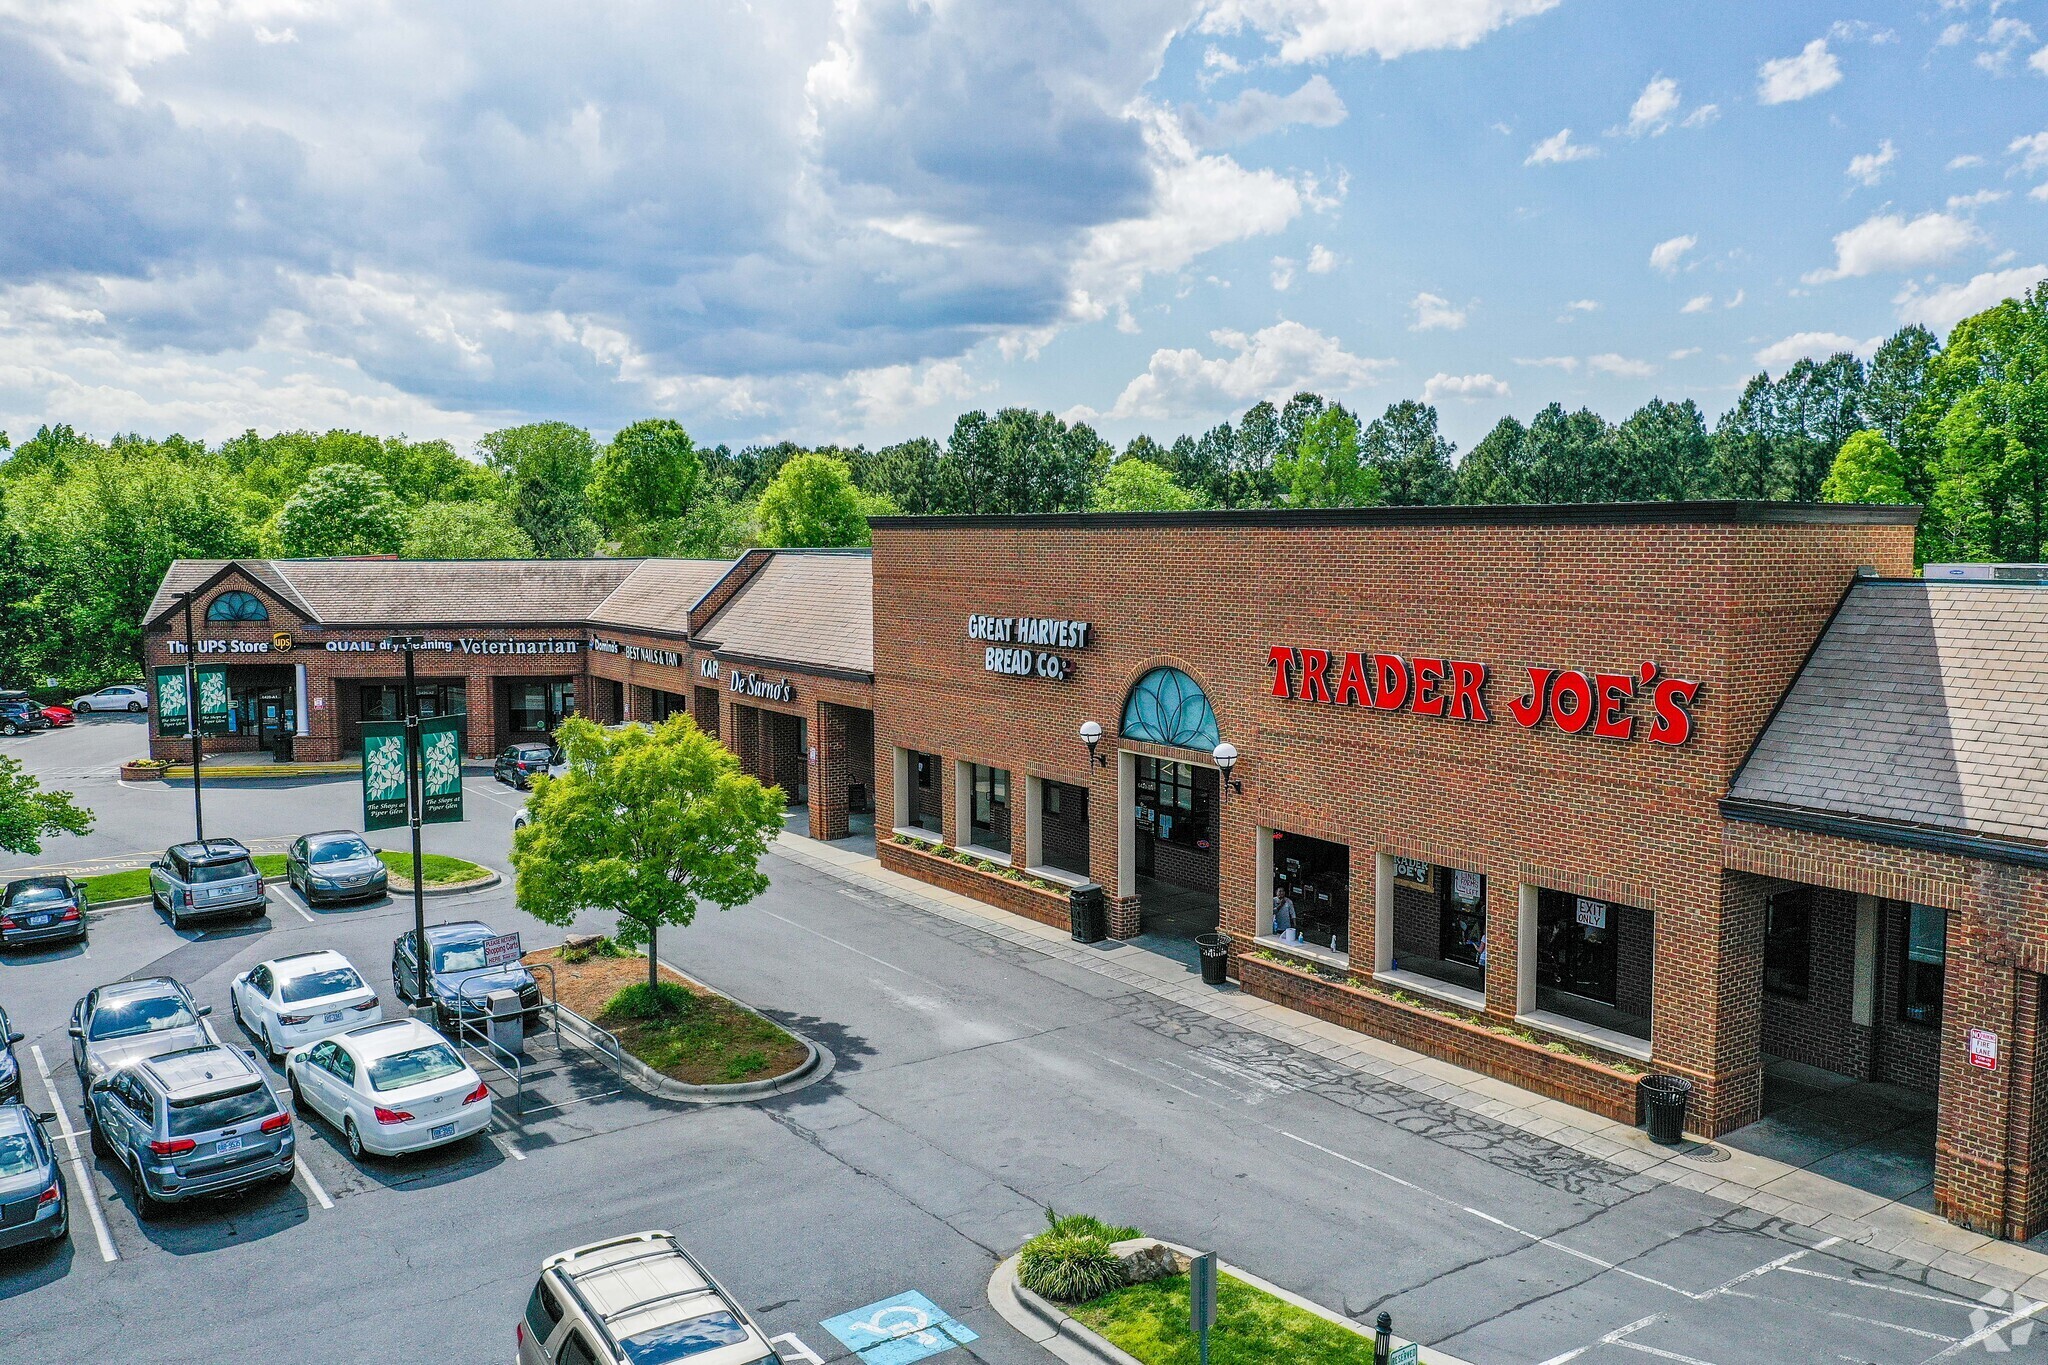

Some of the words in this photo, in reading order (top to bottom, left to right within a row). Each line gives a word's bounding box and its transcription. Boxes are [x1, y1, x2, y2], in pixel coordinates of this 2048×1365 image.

[967, 614, 1013, 642] GREAT
[1018, 617, 1087, 648] HARVEST
[198, 640, 226, 653] UPS
[230, 640, 268, 653] Store
[275, 638, 291, 650] ups
[325, 641, 375, 652] QUAIL
[402, 639, 453, 652] ceaning
[459, 638, 578, 654] Veterinarian
[595, 639, 619, 654] Domino's
[625, 645, 640, 660] BEST
[640, 648, 658, 664] NAILS
[659, 651, 664, 665] &
[665, 652, 678, 667] TAN
[985, 647, 1033, 675] BREAD
[701, 658, 720, 680] KAR
[730, 670, 745, 692] De
[747, 673, 790, 703] Sarno's
[1267, 645, 1491, 723] TRADER
[1507, 661, 1700, 746] JOE'S
[367, 803, 379, 811] The
[380, 802, 398, 810] Shops
[438, 796, 453, 804] Shops
[371, 810, 388, 818] Piper
[1394, 855, 1429, 870] RADER
[1393, 864, 1425, 883] JOE'S
[1580, 901, 1604, 917] EXIT
[1578, 913, 1600, 926] ONLY
[485, 940, 501, 948] PLEASE
[485, 944, 506, 956] Shopping
[506, 942, 519, 950] Carts
[1971, 1030, 1981, 1039] NO
[1976, 1041, 1991, 1049] FIRE
[1975, 1048, 1991, 1057] LANE
[1392, 1349, 1415, 1364] RESERVED
